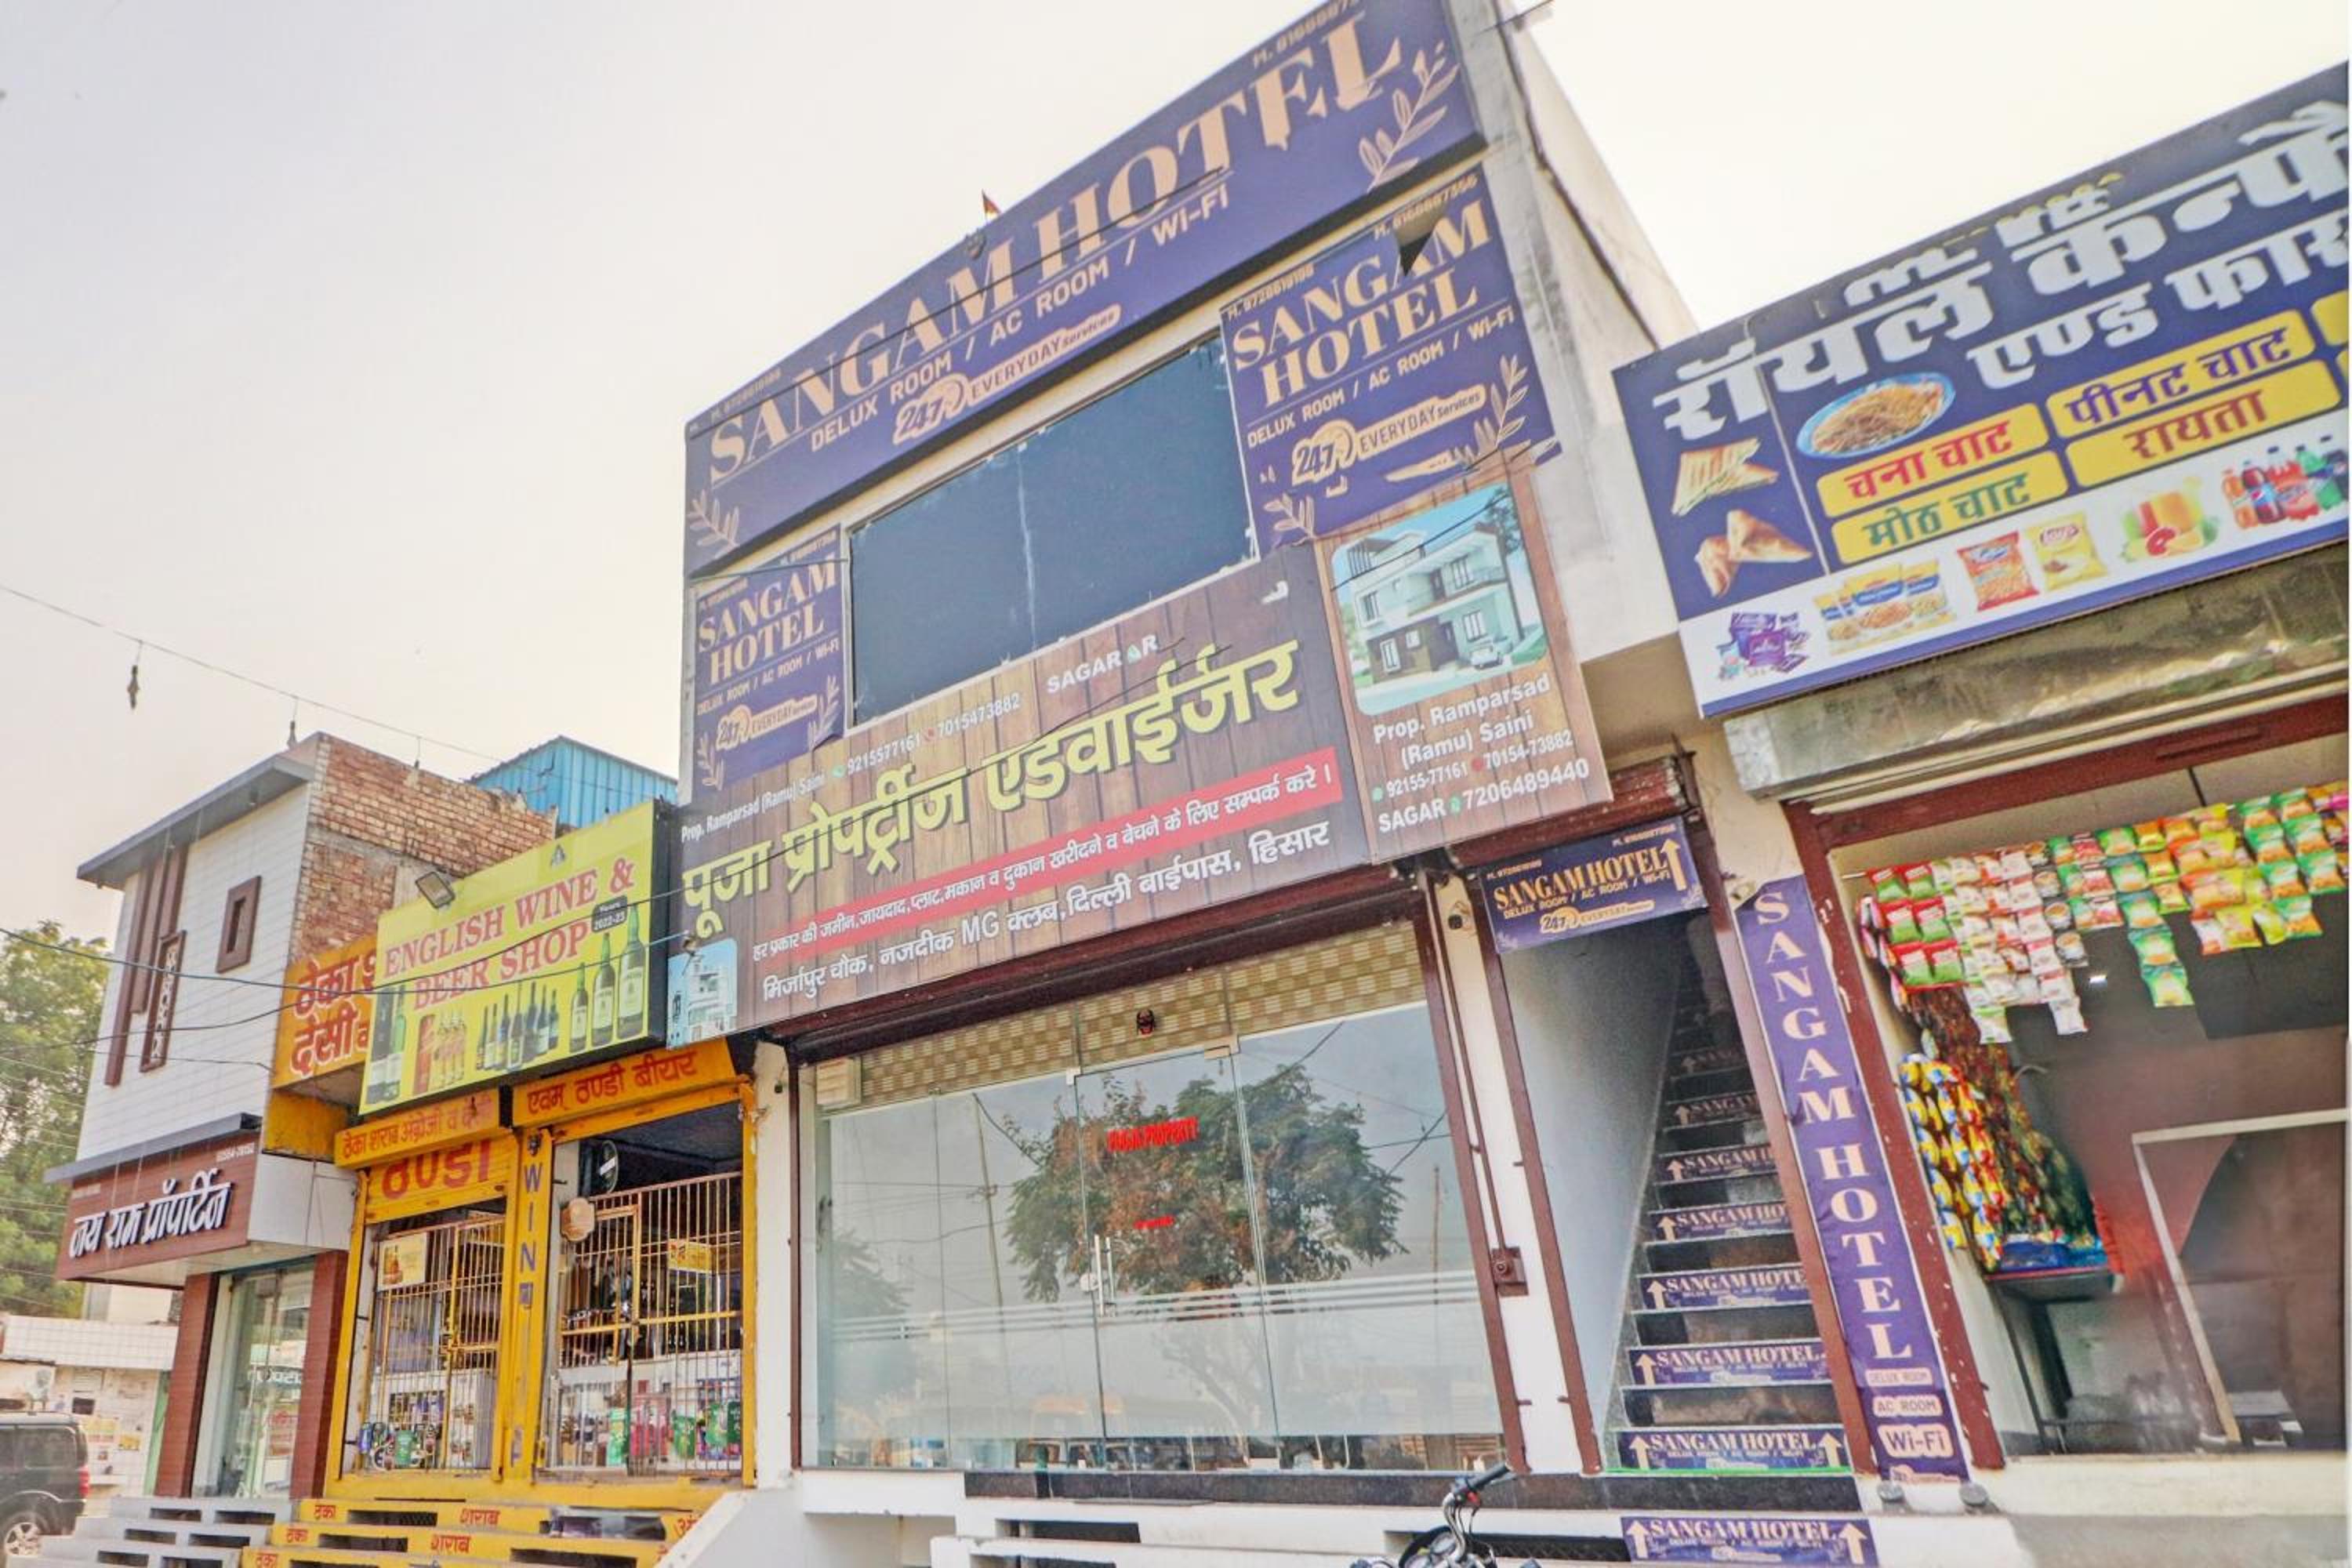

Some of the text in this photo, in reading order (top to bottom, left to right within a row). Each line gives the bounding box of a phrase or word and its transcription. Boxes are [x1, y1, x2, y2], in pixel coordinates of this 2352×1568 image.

[710, 11, 1402, 484] SANGAM HOTEL
[811, 398, 878, 452] DELUX
[890, 354, 952, 401] ROOM
[990, 310, 1023, 347] AC
[1036, 257, 1109, 318] ROOM
[971, 337, 1062, 398] EVERYDAY
[1259, 267, 1478, 408] HOTEL
[2066, 323, 2292, 426] पीनट चाट
[1248, 417, 1296, 448] DELUX
[1302, 391, 1345, 422] ROOM
[1369, 365, 1391, 390] AC
[1397, 341, 1444, 377] ROOM
[1359, 405, 1437, 452] EVERYDAY
[2124, 390, 2268, 459] रायता
[1845, 419, 2014, 502] चना चाट
[1863, 472, 2032, 550] मोठ चाट
[699, 552, 836, 652] SANGAM
[710, 601, 824, 685] HOTEL
[1047, 648, 1123, 694] SAGAR
[1372, 673, 1552, 745] Prop. Ramparsad
[1400, 708, 1535, 771] (Ramu) Saini
[681, 823, 706, 843] Prop.
[706, 797, 760, 833] Ramparsad
[847, 734, 923, 775] 9215577161
[937, 691, 1020, 738] 7015473882
[1377, 757, 1591, 833] SAGAR 7206489440
[1385, 729, 1574, 800] 92155-77161 70154-73882
[682, 840, 774, 938] पूजा
[801, 922, 817, 943] की
[1003, 855, 1045, 891] दुकान
[1163, 806, 1182, 833] के
[1185, 796, 1221, 824] लिए
[1224, 776, 1281, 815] सम्पर्क
[1494, 865, 1585, 911] SANGAM
[1586, 847, 1668, 887] HOTEL
[1600, 880, 1629, 895] ROOM
[383, 905, 505, 978] ENGLISH
[515, 868, 597, 927] WINE
[609, 858, 634, 895] &
[763, 965, 828, 1001] मिर्जापुर
[879, 929, 956, 966] नजदीक
[961, 911, 1000, 946] MG
[1247, 820, 1331, 866] हिसार
[414, 956, 489, 1009] BEER
[499, 920, 590, 983] SHOP
[576, 1059, 626, 1103] ठण्डी
[632, 1050, 698, 1087] बीयर
[1753, 891, 1913, 1359] SANGAM HOTEL
[1675, 1207, 1752, 1225] SANGAM
[1666, 1270, 1748, 1293] SANGAM
[1656, 1347, 1742, 1367] SANGAM
[1744, 1345, 1820, 1363] HOTEL
[1650, 1432, 1817, 1451] SANGAM HOTEL
[1878, 1399, 1938, 1411] AC ROOM
[1885, 1430, 1947, 1451] Wi-Fi
[1649, 1519, 1836, 1539] SANGAM HOTEL
